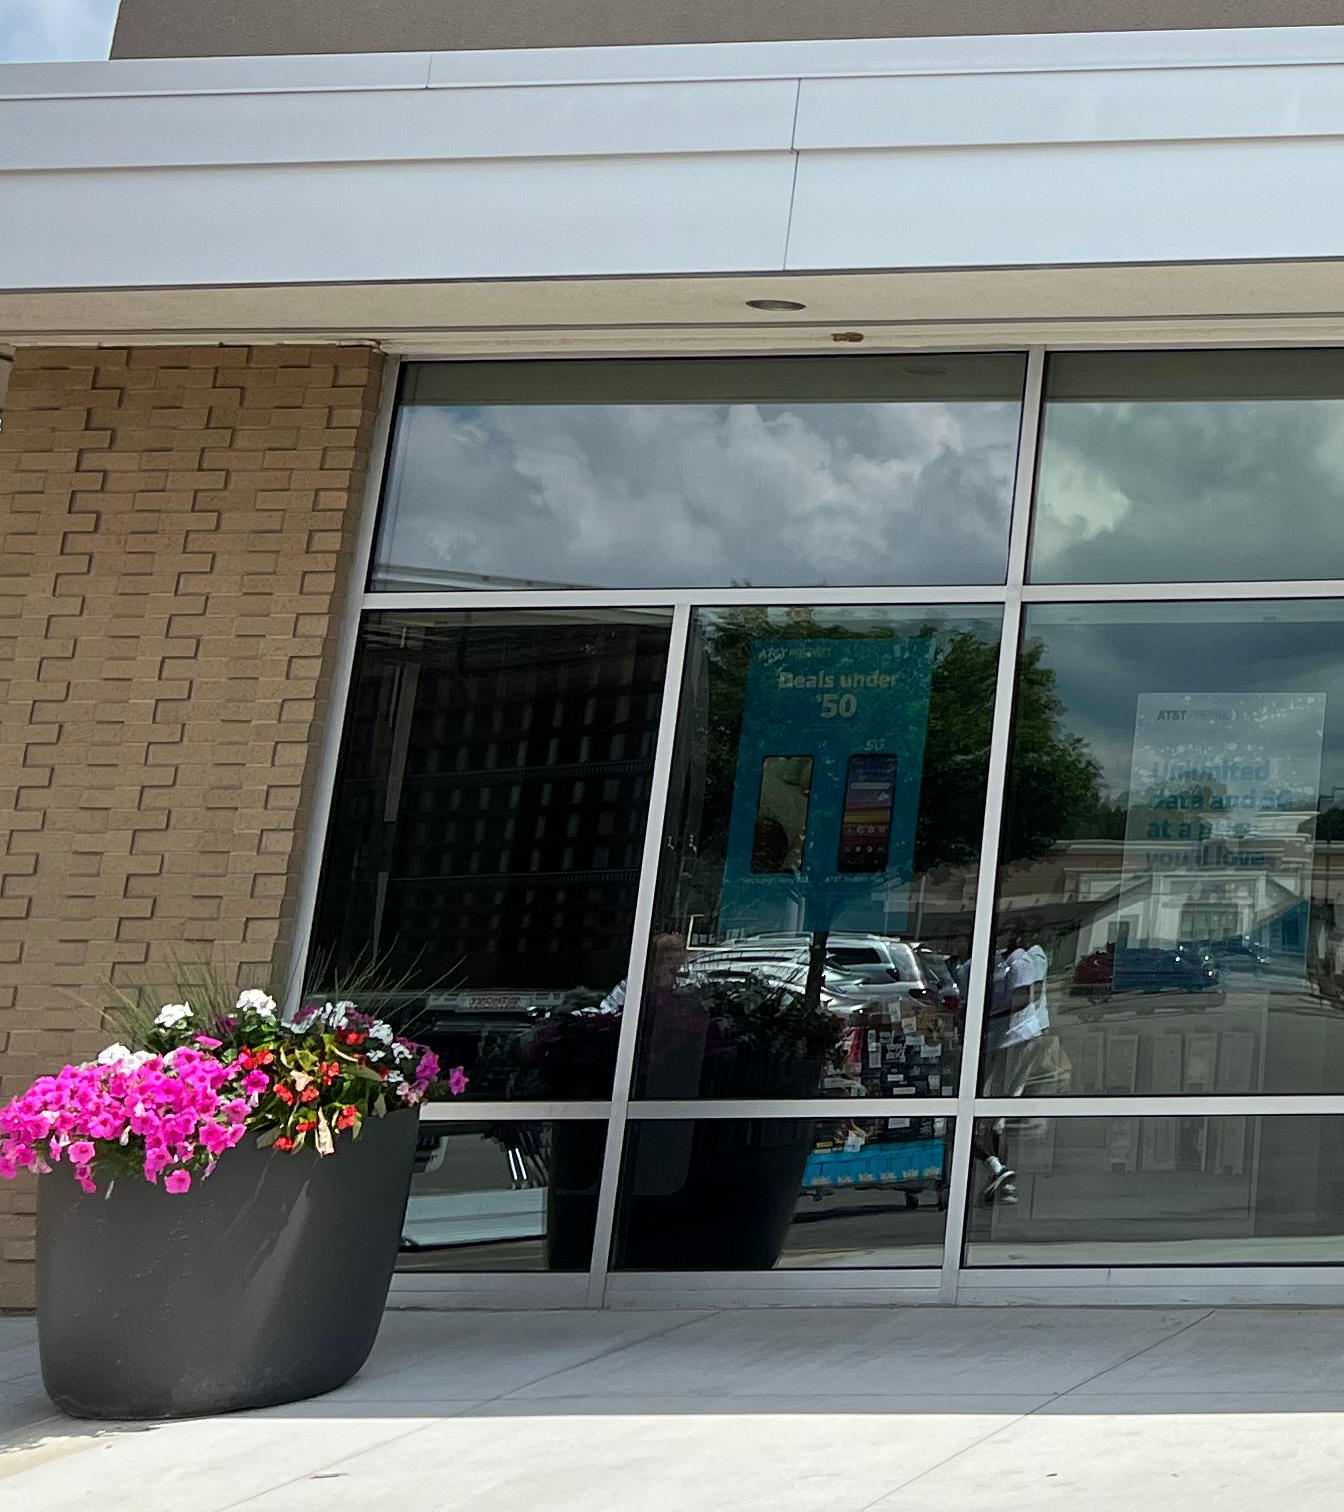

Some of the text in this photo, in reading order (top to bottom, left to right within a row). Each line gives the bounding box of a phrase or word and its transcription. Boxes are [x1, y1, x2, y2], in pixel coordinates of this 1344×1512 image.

[778, 670, 899, 688] Deals under
[1157, 710, 1188, 721] AT&T
[1211, 788, 1257, 809] and
[1147, 819, 1171, 839] at
[1178, 822, 1192, 839] a
[1216, 845, 1265, 867] love
